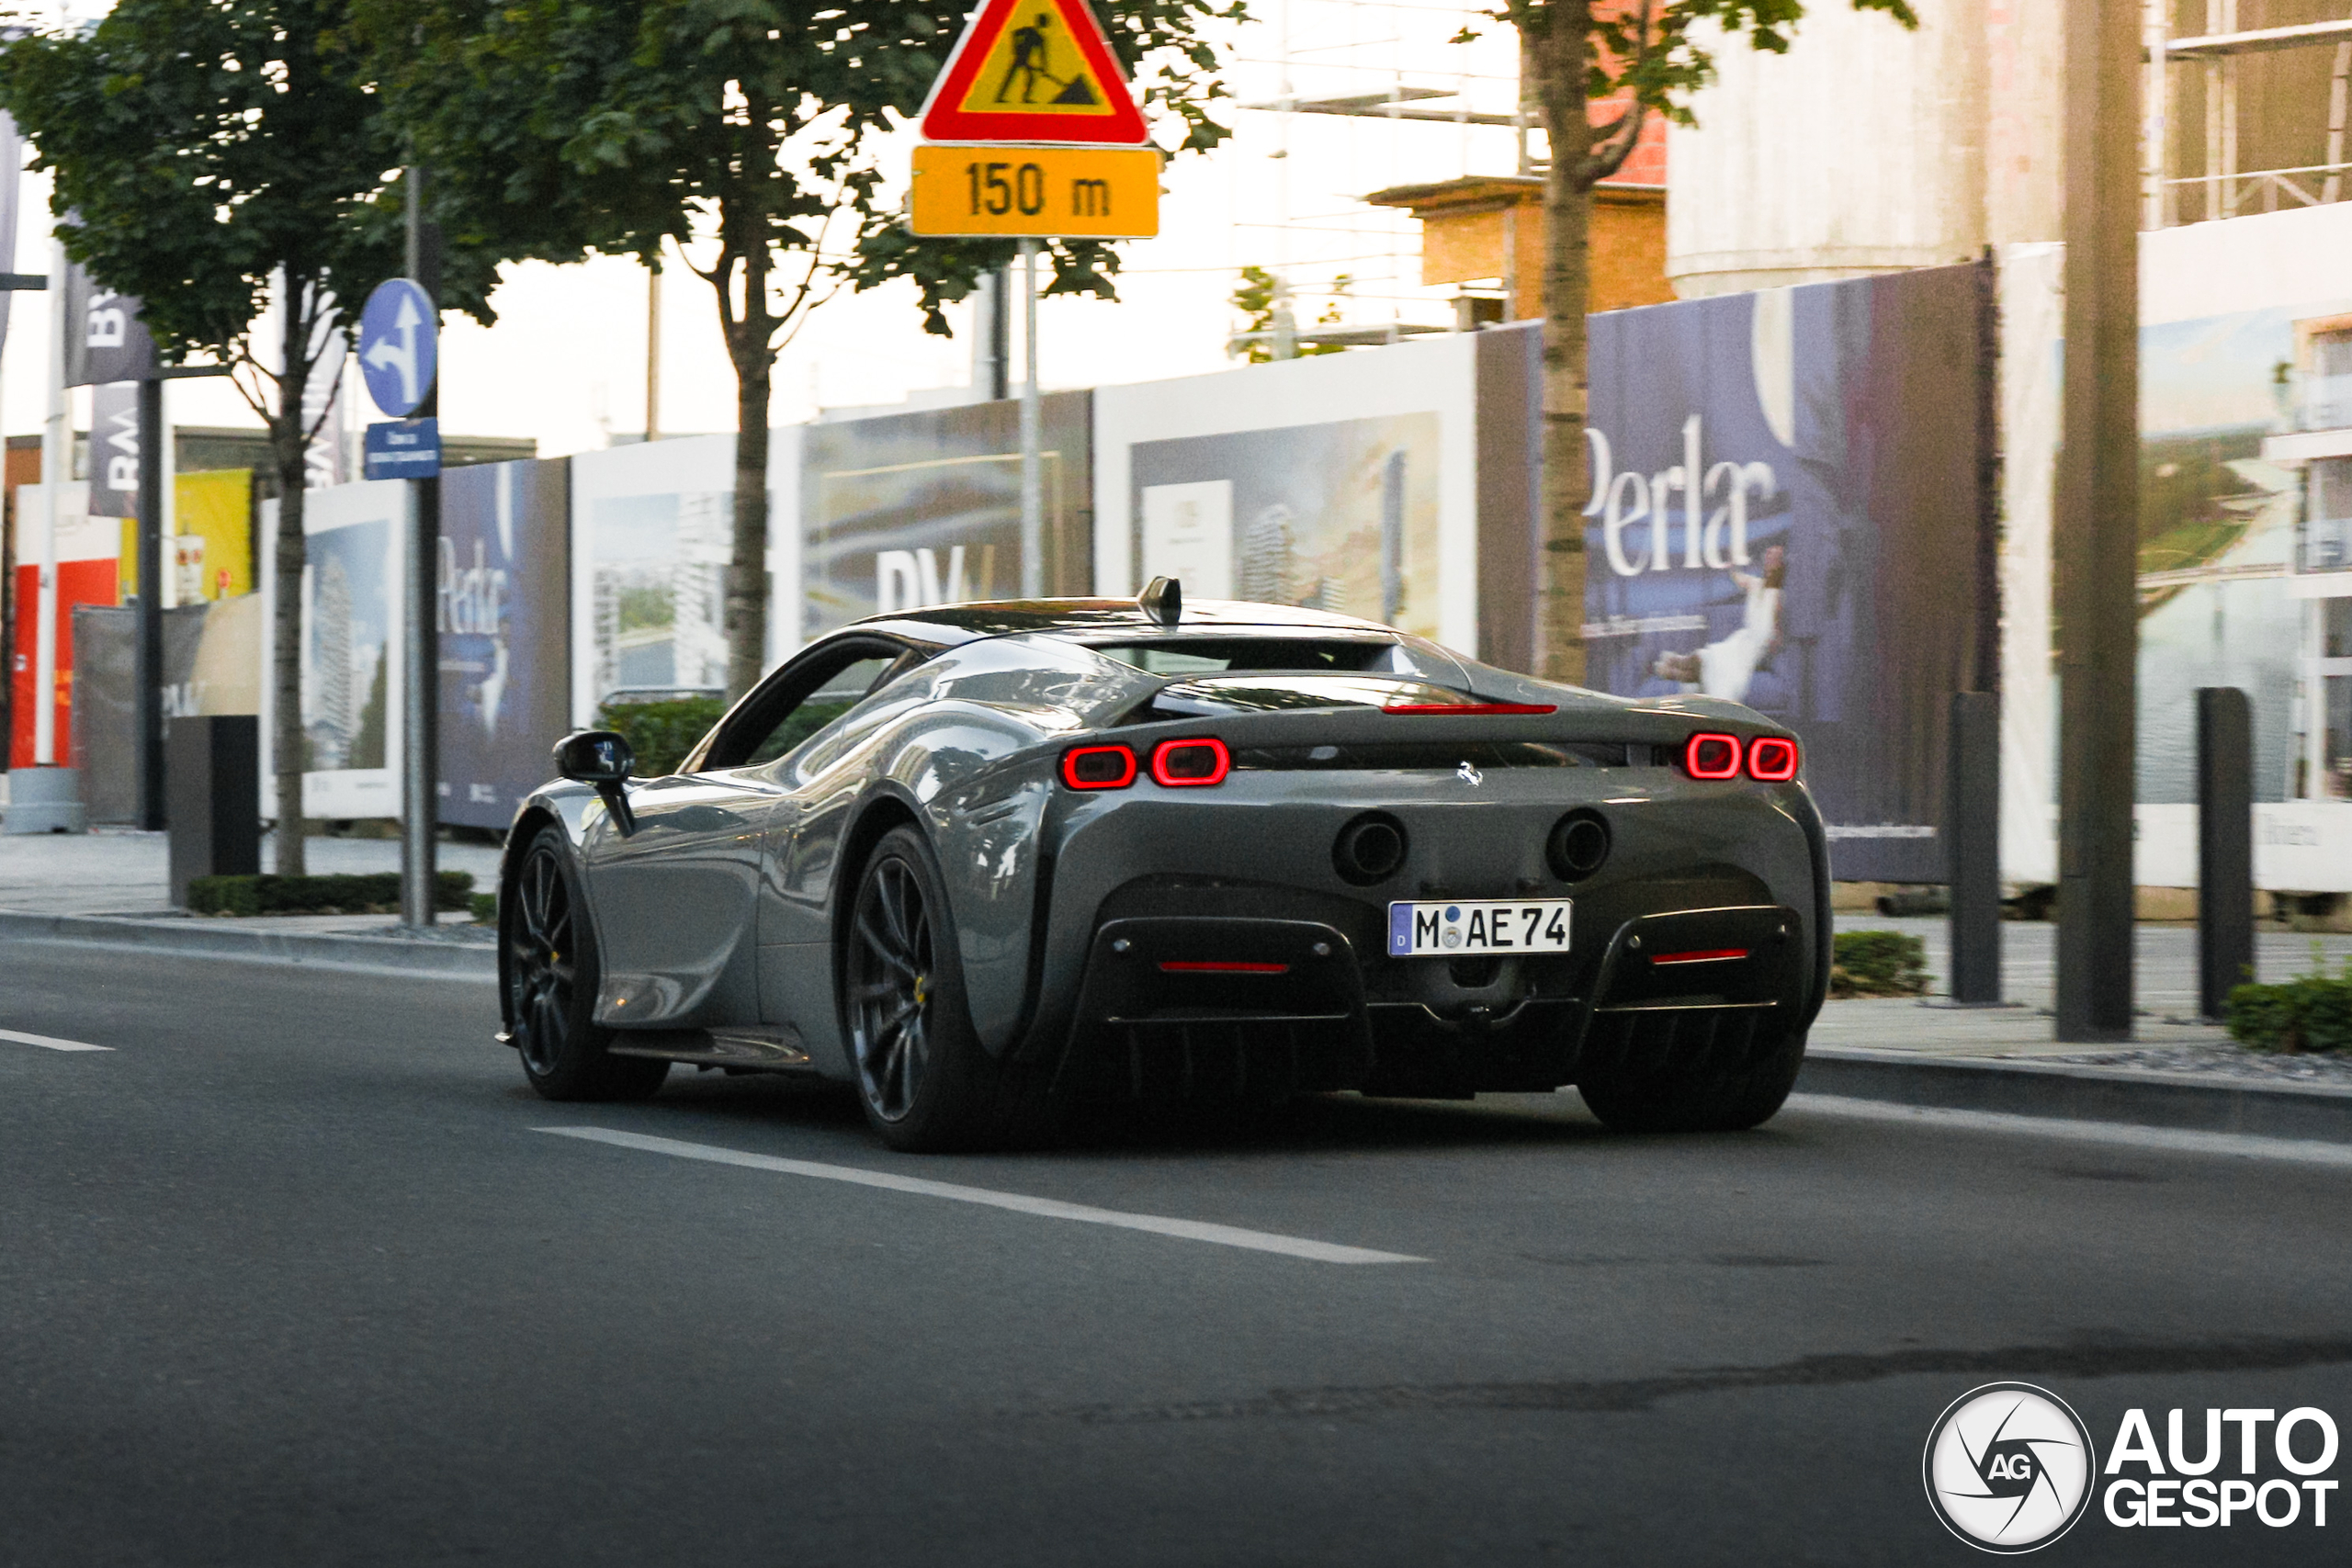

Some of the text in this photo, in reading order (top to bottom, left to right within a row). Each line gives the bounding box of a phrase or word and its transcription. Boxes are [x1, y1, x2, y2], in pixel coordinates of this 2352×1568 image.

[967, 162, 1110, 217] 150 m
[1396, 935, 1406, 947] D
[1416, 909, 1440, 949] M
